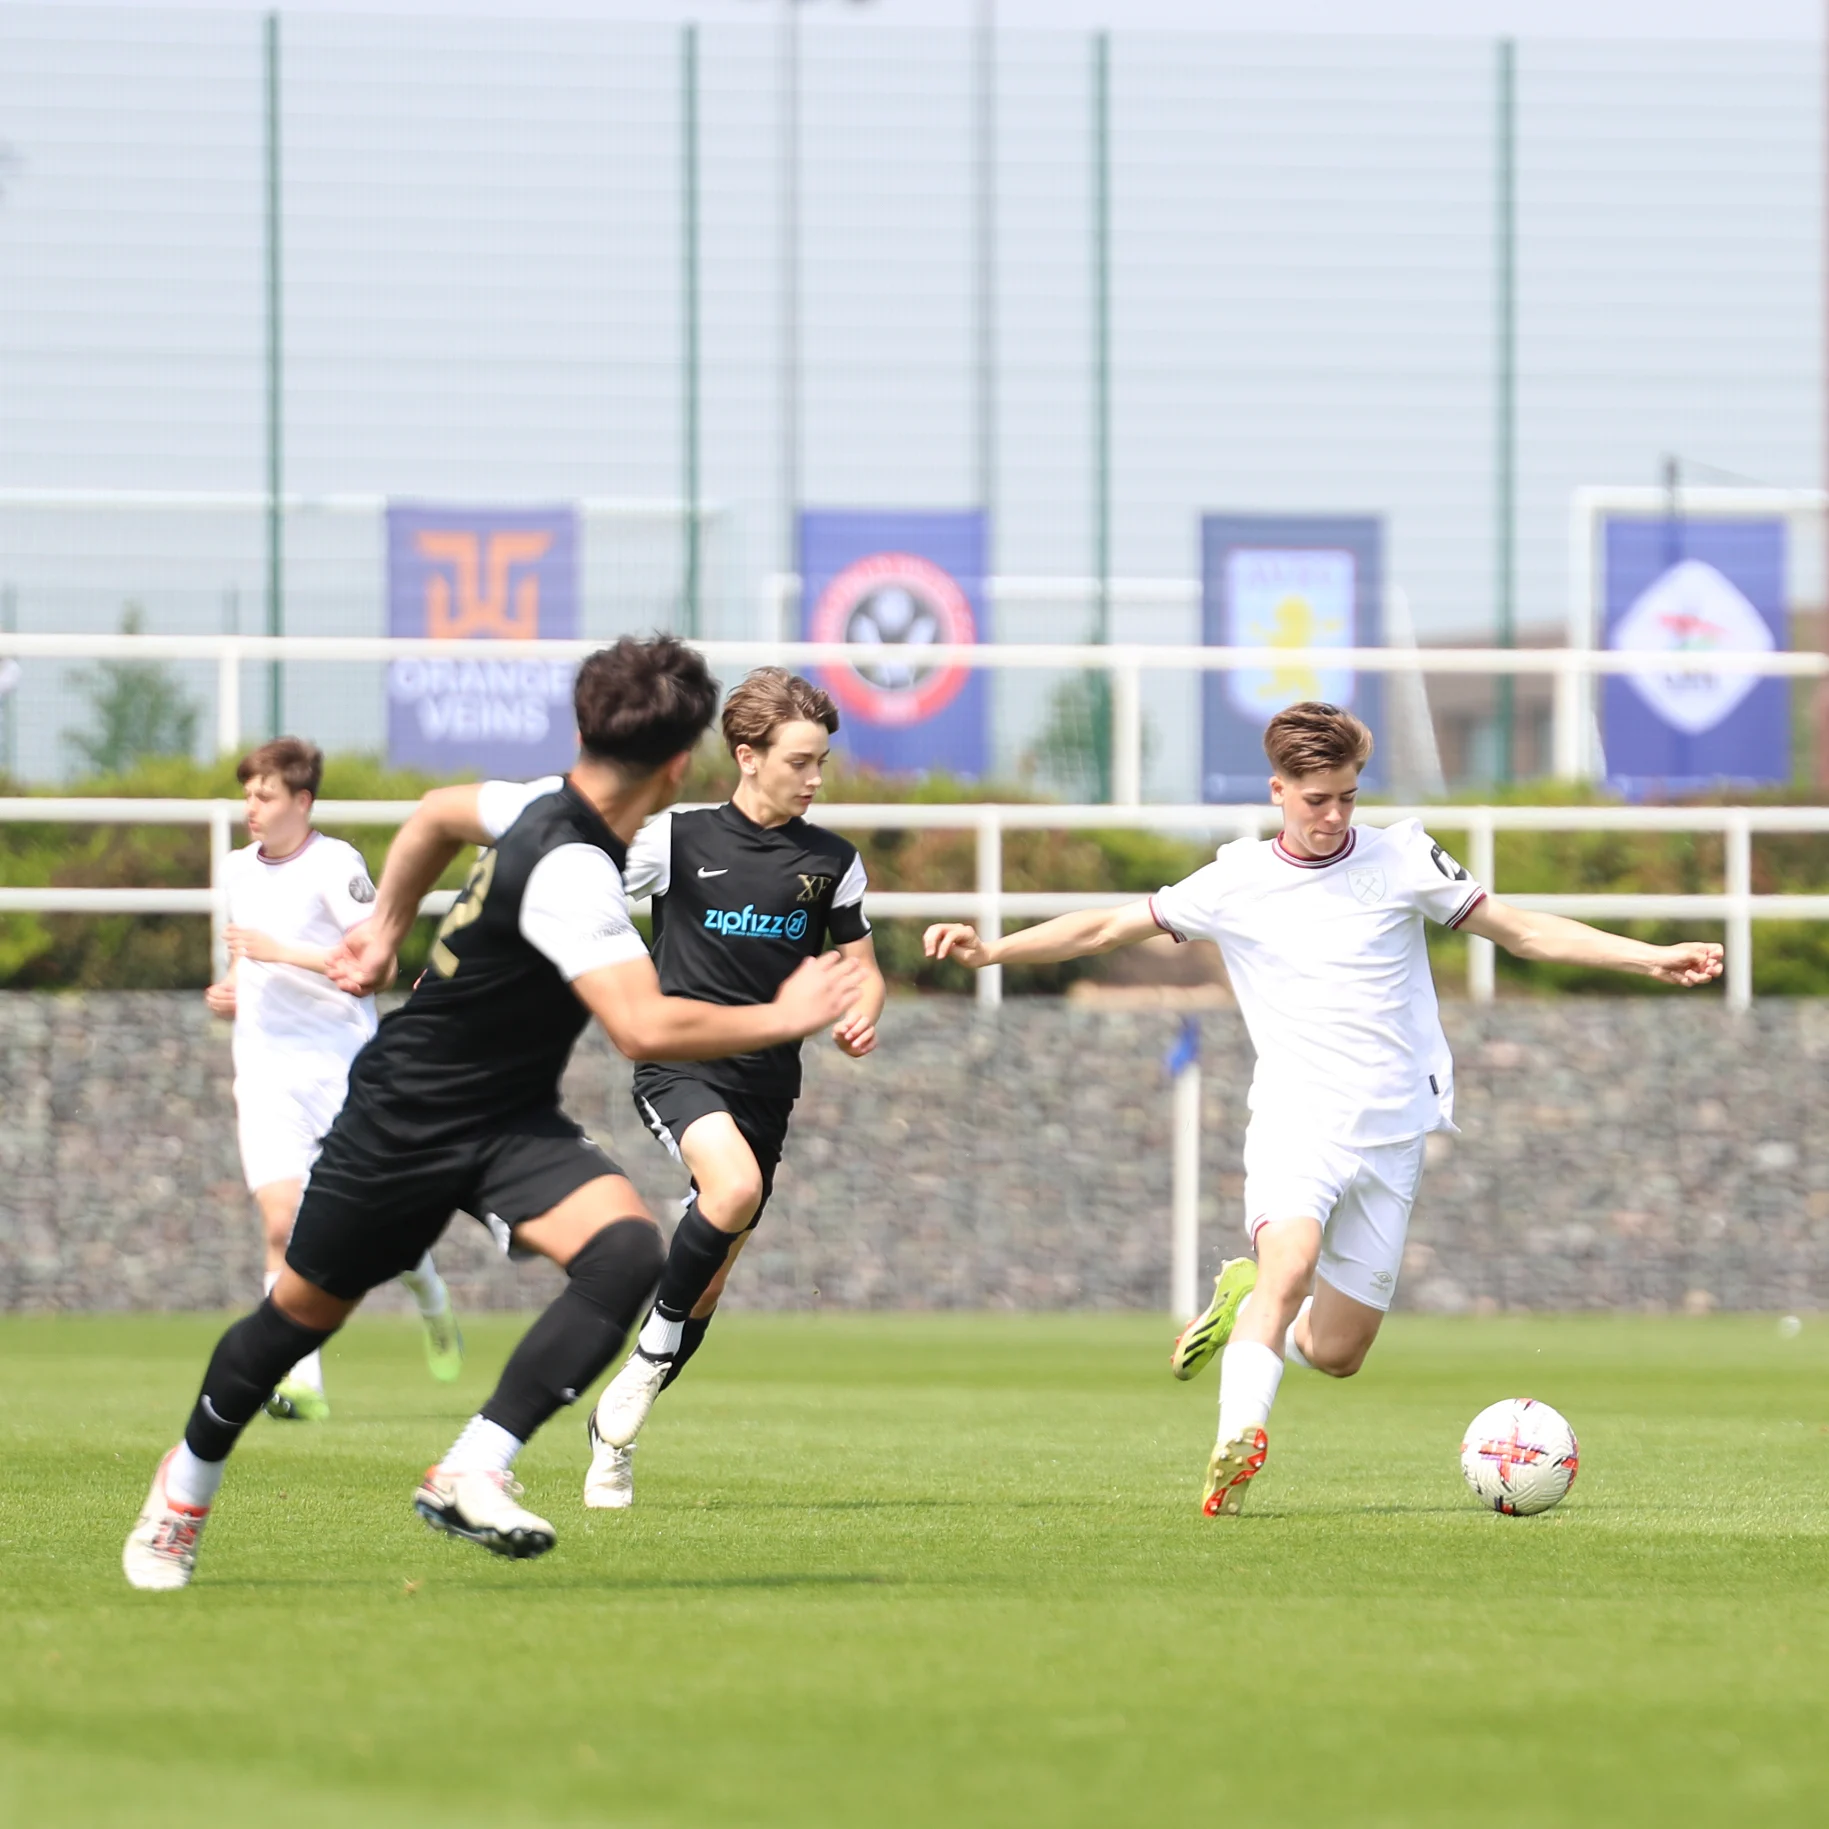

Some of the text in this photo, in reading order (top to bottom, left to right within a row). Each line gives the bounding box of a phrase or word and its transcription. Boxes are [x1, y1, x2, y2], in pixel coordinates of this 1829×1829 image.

[388, 655, 573, 702] ORANGE
[416, 696, 550, 744] VEINS
[704, 904, 785, 936] zipfizz
